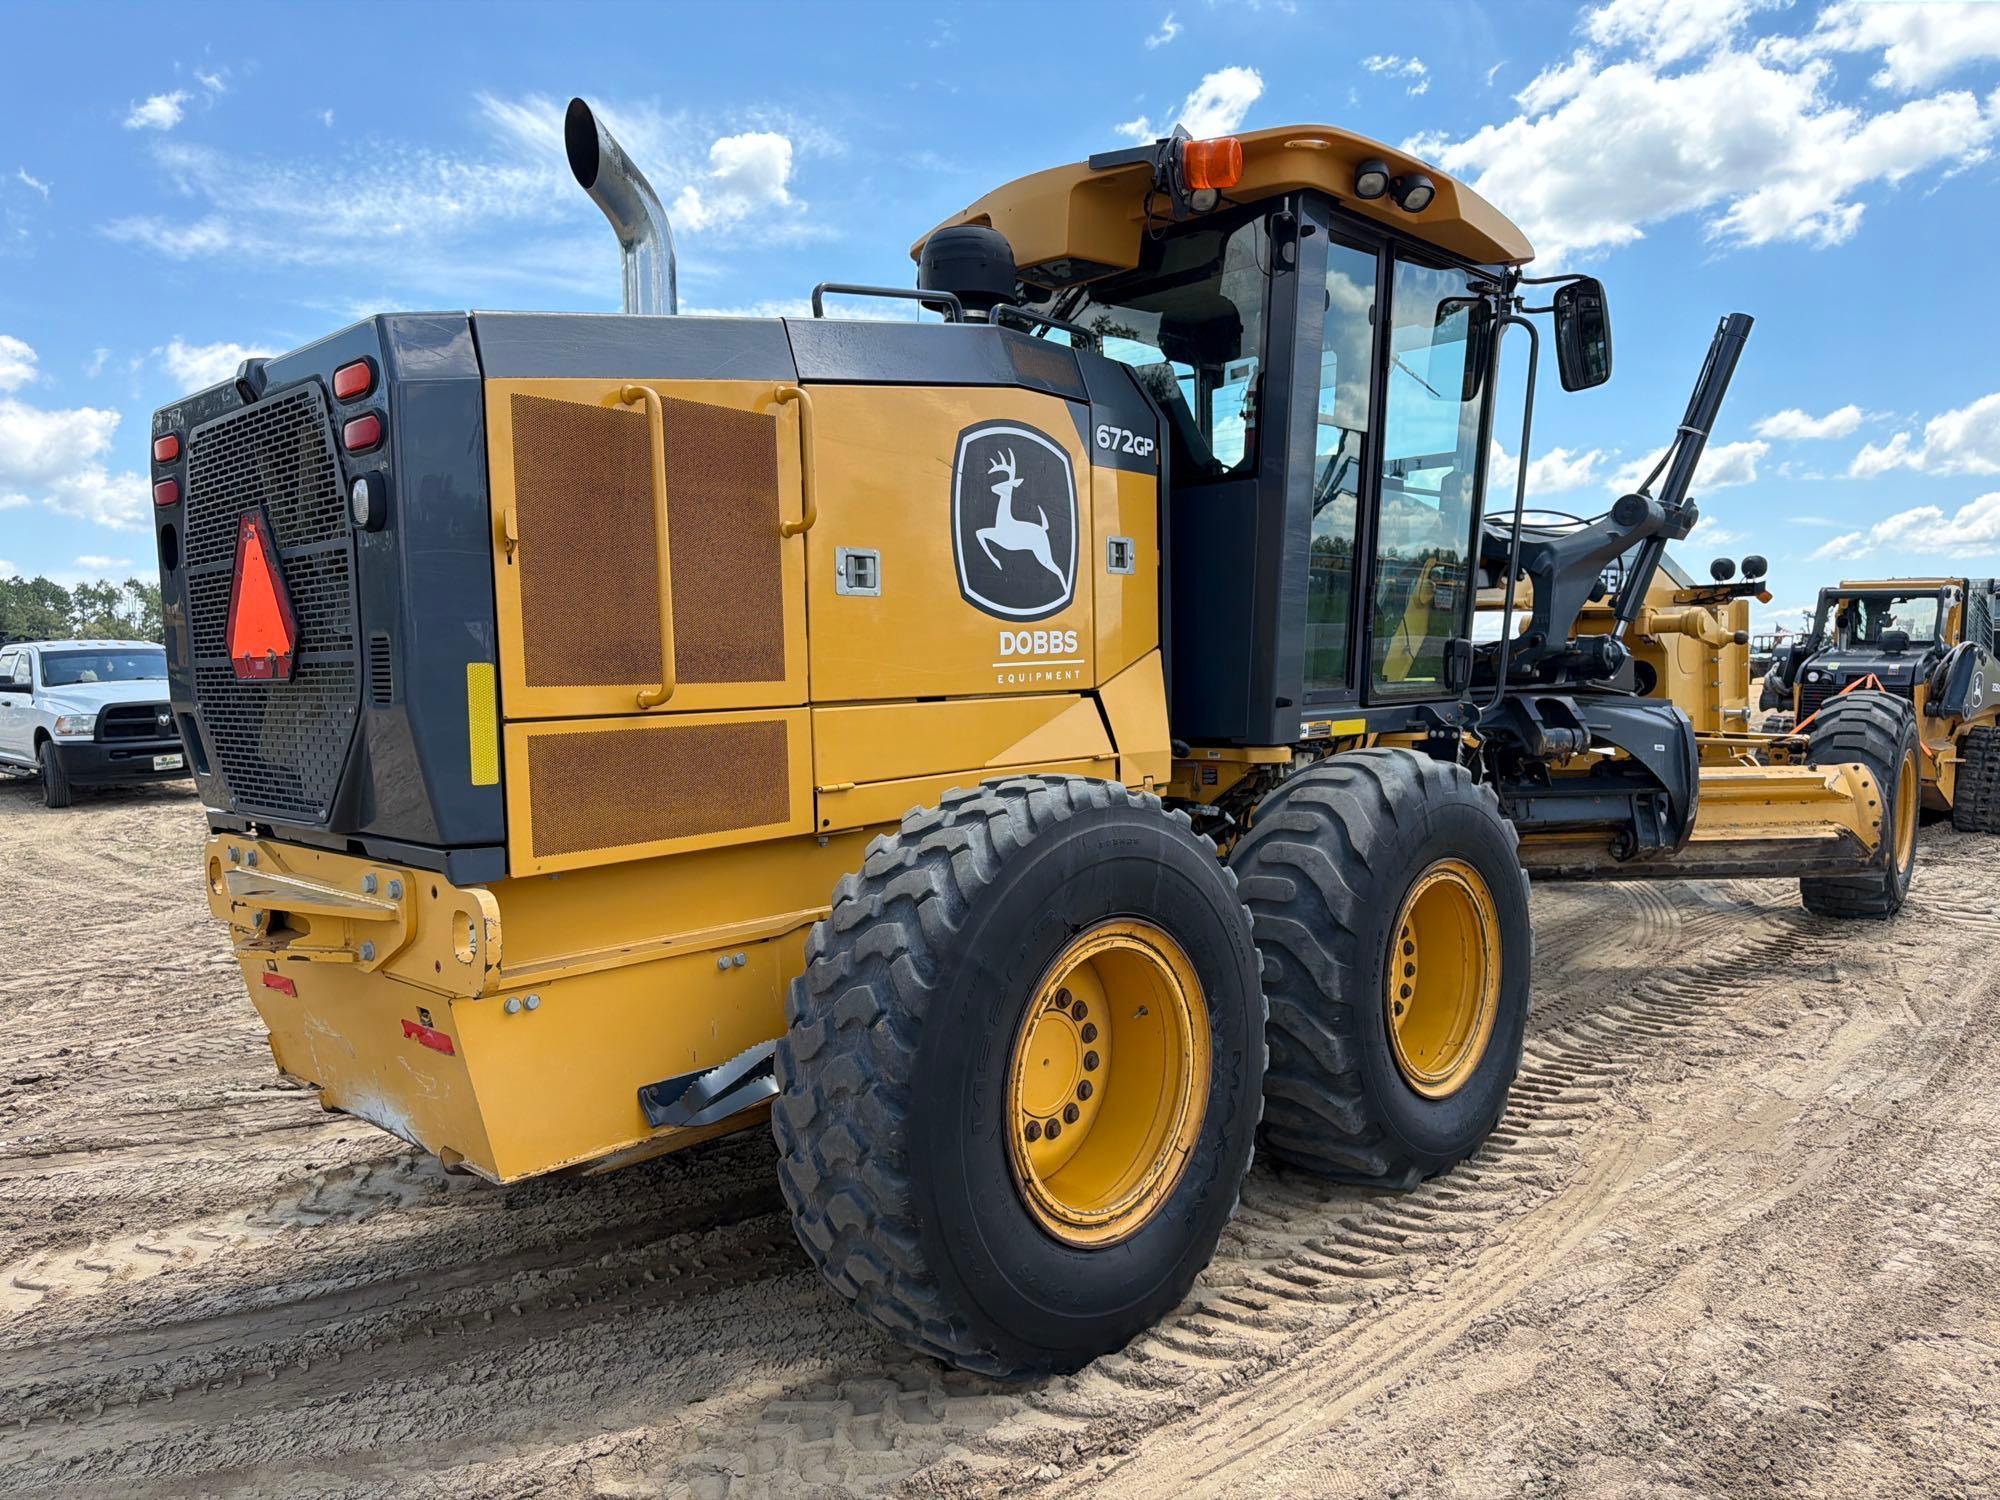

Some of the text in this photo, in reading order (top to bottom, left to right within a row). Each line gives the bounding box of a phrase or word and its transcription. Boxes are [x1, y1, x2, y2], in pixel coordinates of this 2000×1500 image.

[1096, 424, 1154, 457] 672GP
[1000, 630, 1078, 656] DOBBS
[997, 670, 1080, 684] EQUIPMENT
